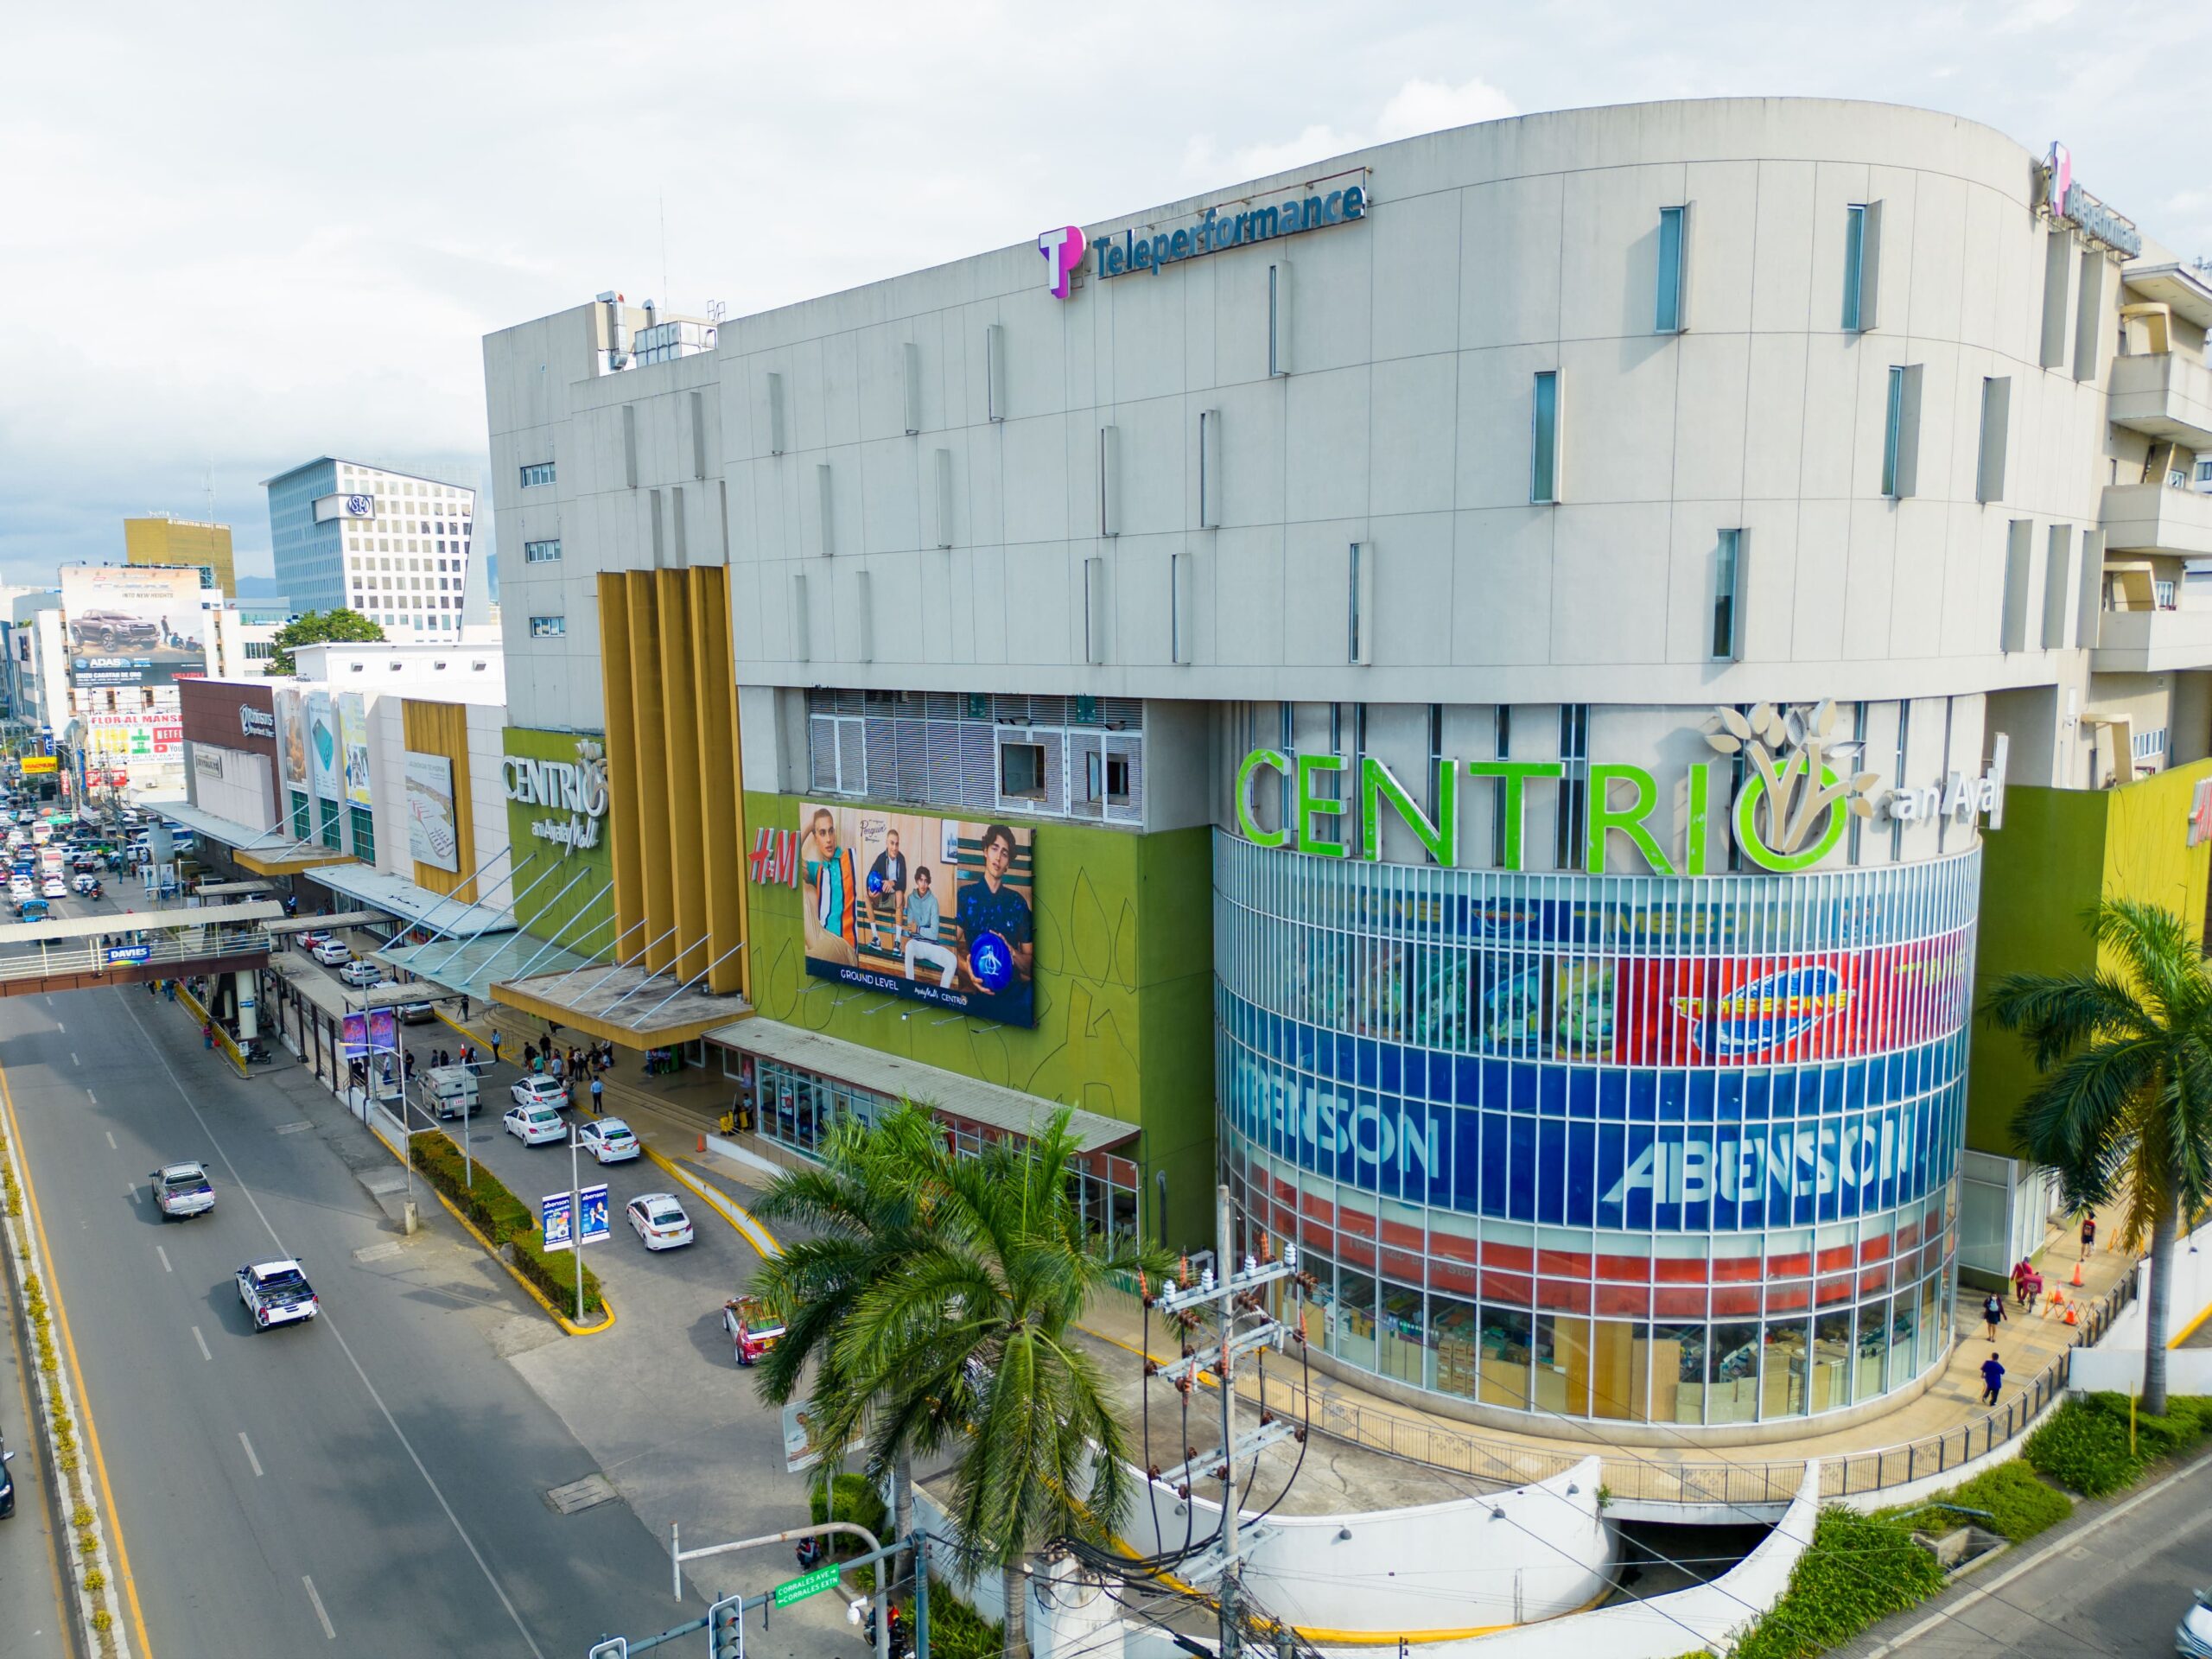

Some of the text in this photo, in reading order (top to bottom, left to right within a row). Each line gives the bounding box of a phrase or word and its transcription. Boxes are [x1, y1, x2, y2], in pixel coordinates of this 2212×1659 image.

[1093, 186, 1367, 276] Teleperformance
[501, 755, 608, 817] CENTRIO
[1236, 748, 1848, 878] CENTRIO
[1890, 787, 1941, 821] an
[748, 828, 801, 889] H&M
[111, 948, 147, 958] DAVIES
[841, 969, 899, 991] GROUND LEVEL
[1600, 1116, 1910, 1204] ABENSON
[543, 1199, 569, 1209] abenson
[582, 1192, 607, 1201] abenson
[779, 1571, 830, 1595] CORRALES AVE
[784, 1577, 838, 1602] CORRALES EXTN
